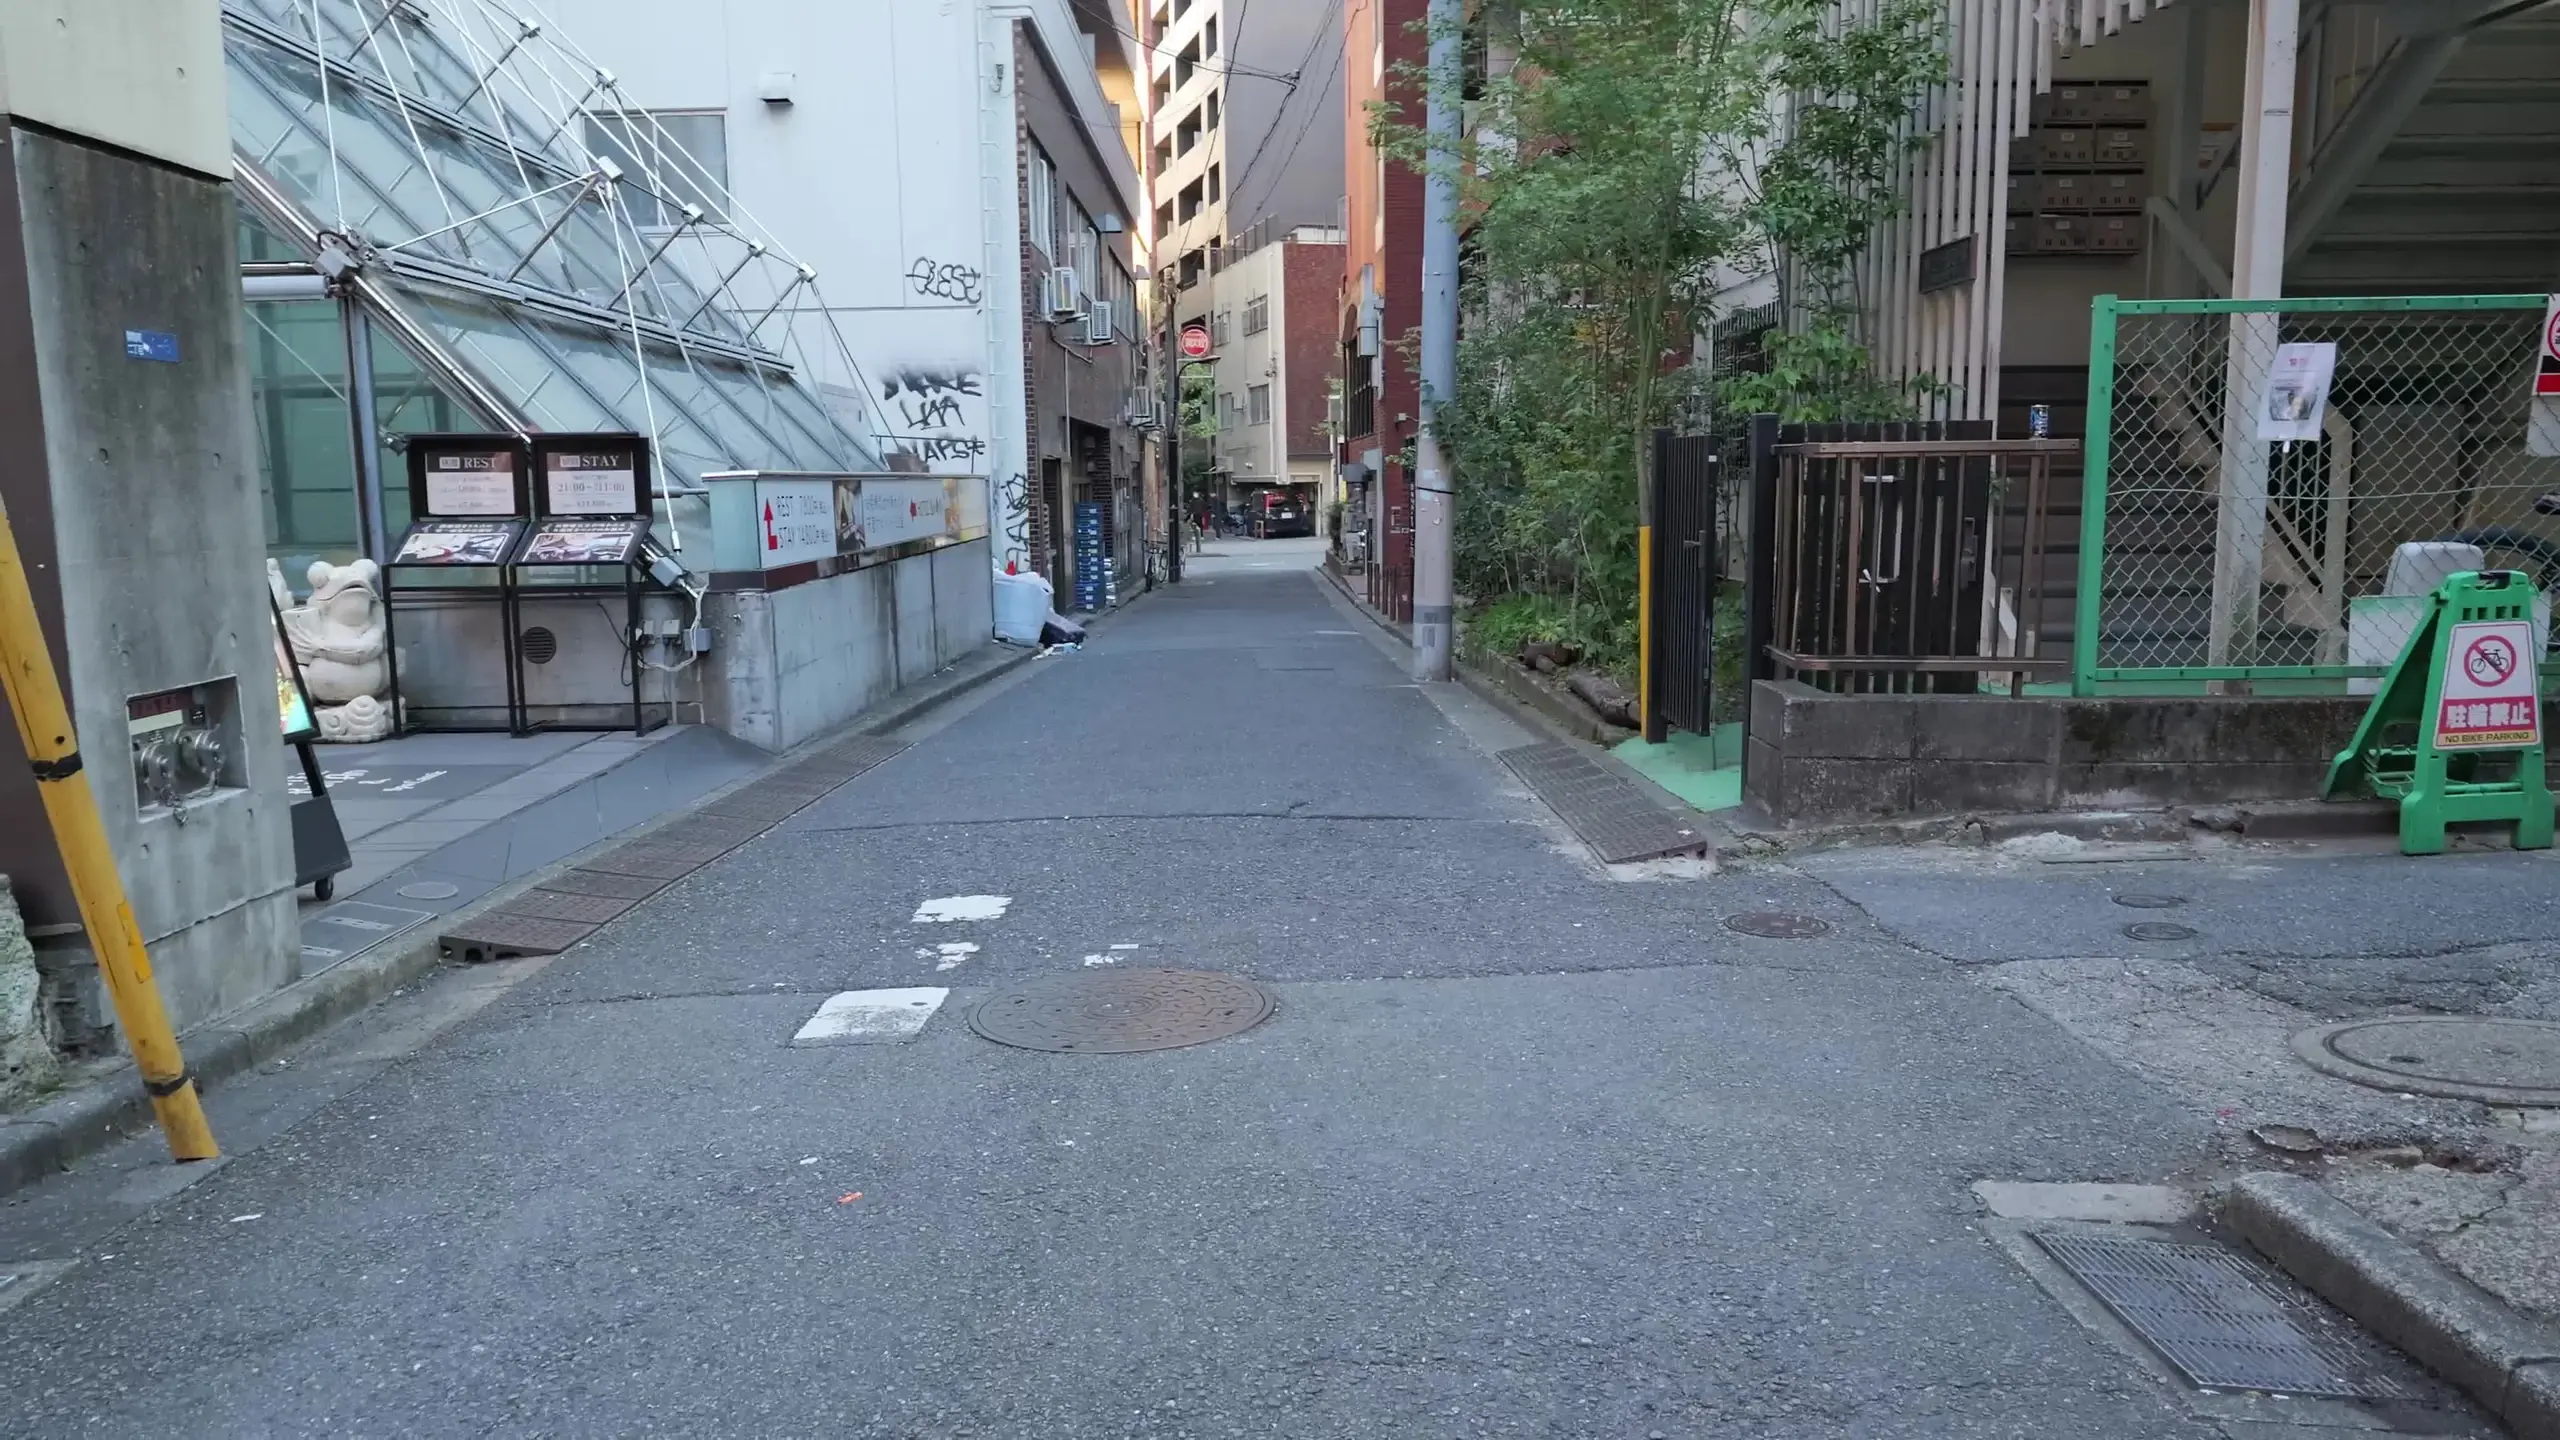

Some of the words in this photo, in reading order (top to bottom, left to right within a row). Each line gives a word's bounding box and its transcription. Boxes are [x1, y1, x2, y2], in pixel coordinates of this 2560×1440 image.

[463, 457, 497, 469] REST
[582, 455, 619, 467] STAY
[2446, 701, 2531, 729] 駐輪禁止
[2445, 734, 2460, 744] NO
[2461, 733, 2484, 743] BIKE
[2486, 731, 2529, 742] PARKING
